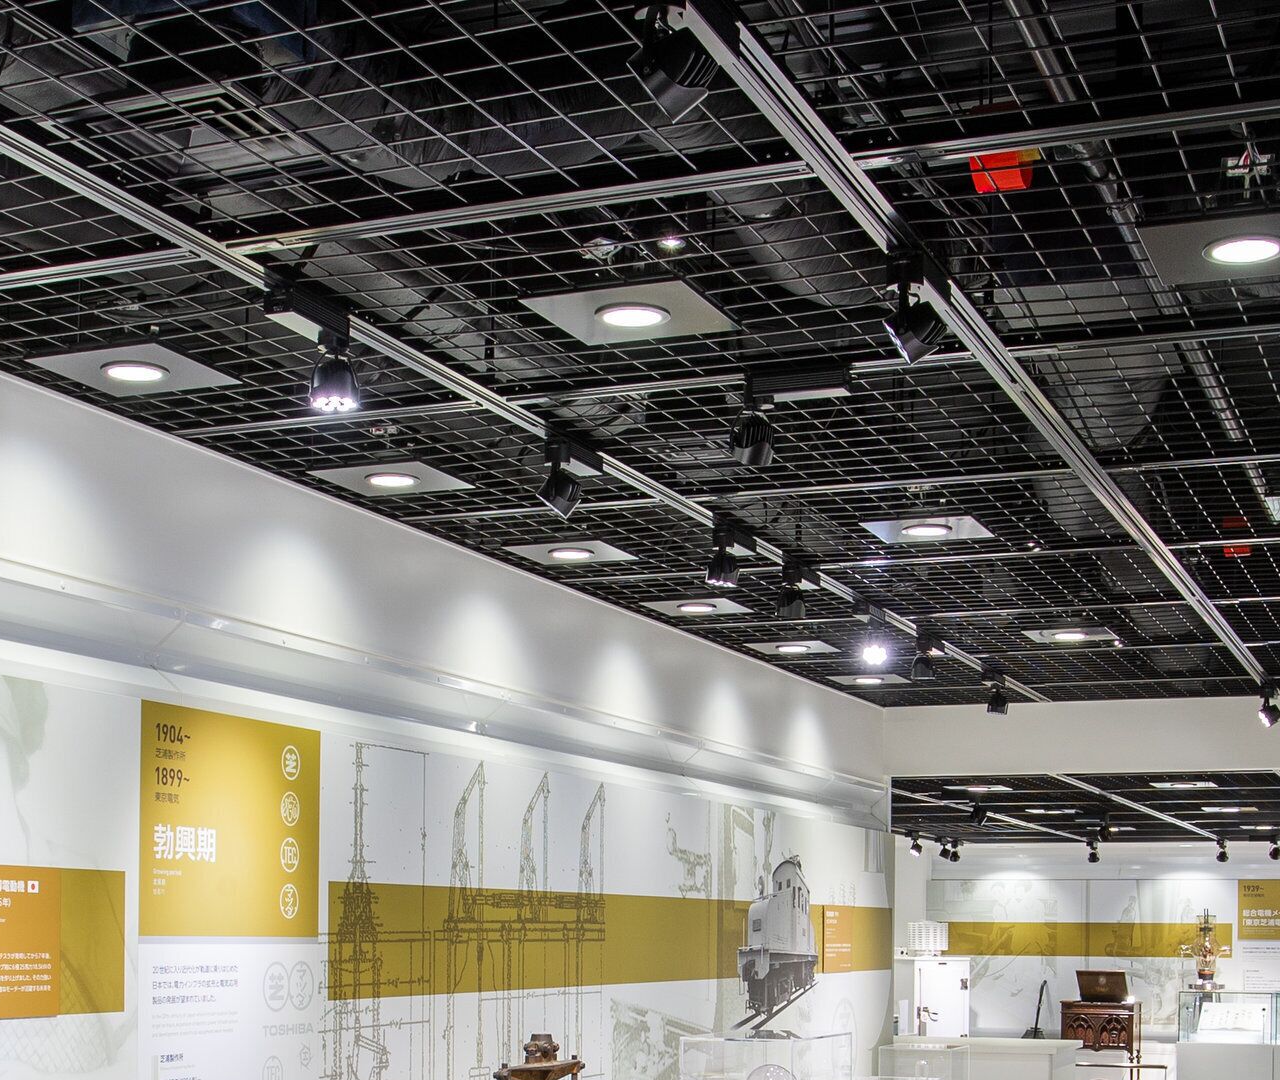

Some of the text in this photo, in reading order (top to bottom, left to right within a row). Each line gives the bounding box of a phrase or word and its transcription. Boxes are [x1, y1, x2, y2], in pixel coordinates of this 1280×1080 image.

[153, 823, 217, 863] 勃興期
[262, 1022, 314, 1038] TOSHIBA
